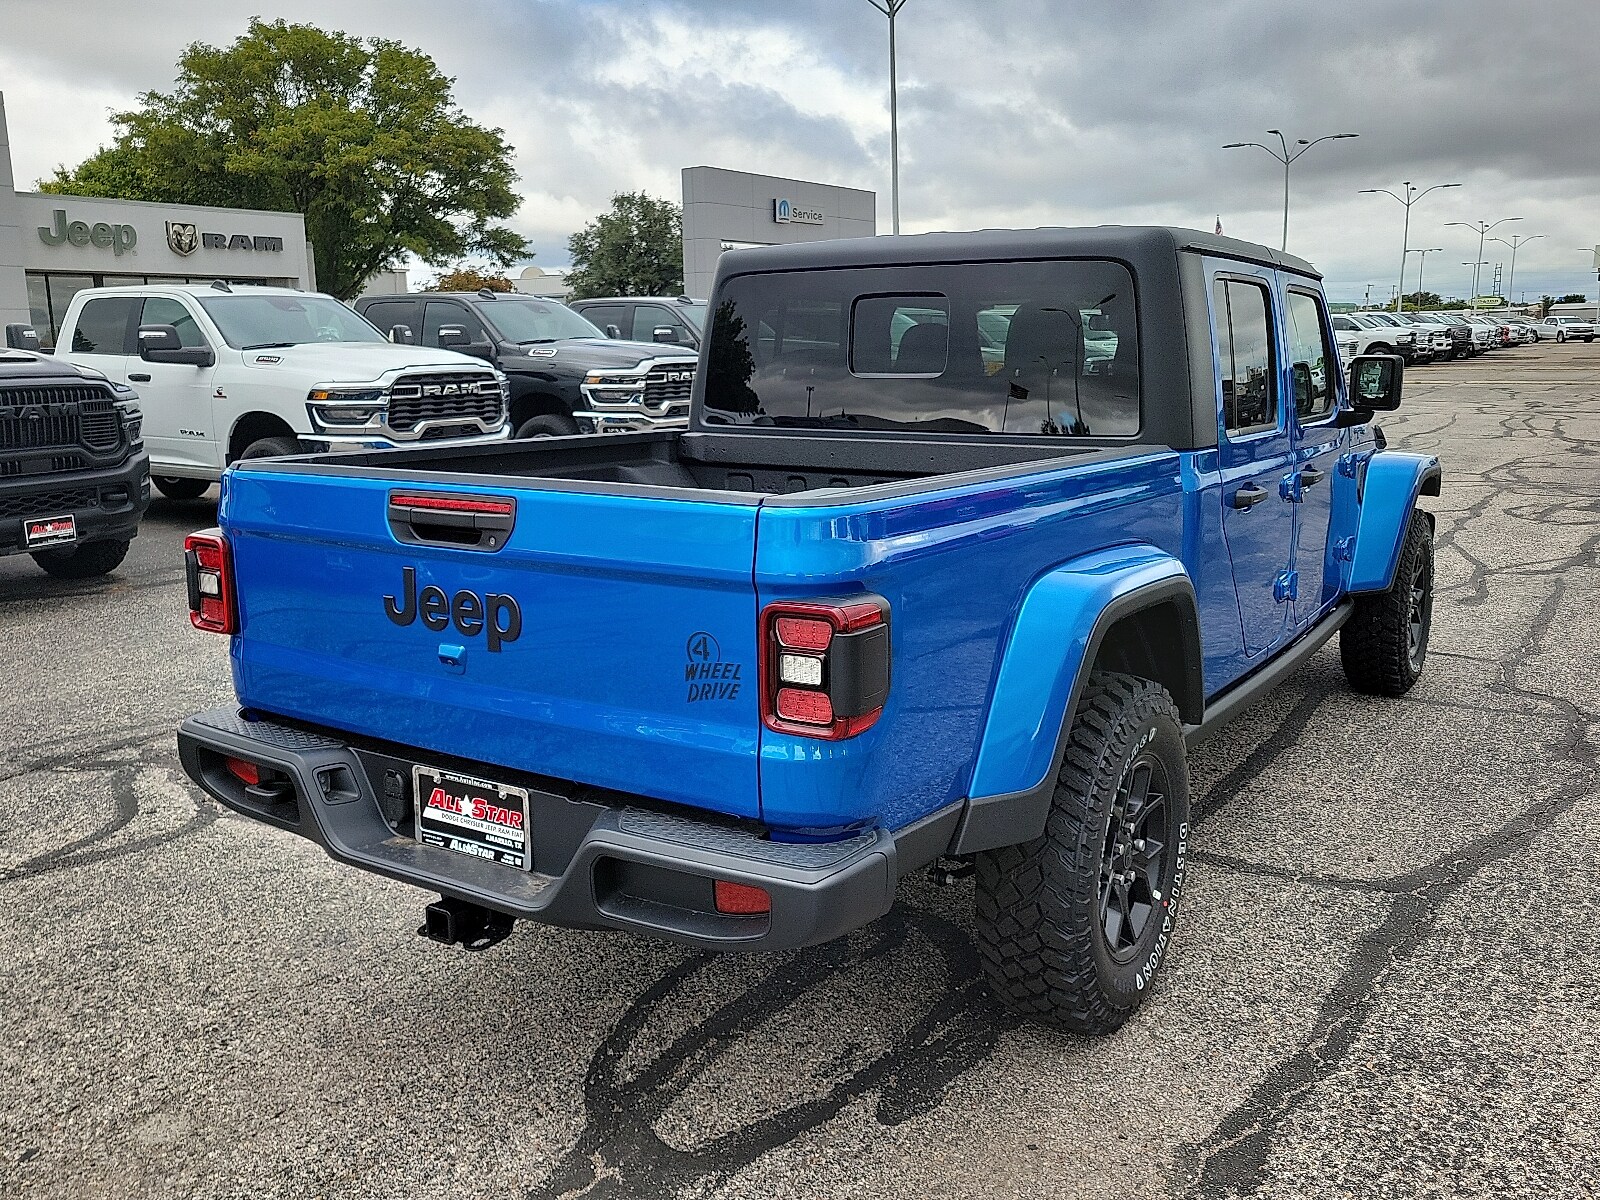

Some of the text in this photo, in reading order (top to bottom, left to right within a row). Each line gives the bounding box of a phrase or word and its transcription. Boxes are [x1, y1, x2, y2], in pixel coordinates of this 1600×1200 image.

[792, 207, 823, 221] Service
[38, 210, 137, 256] Jeep
[202, 233, 283, 252] RAM
[422, 383, 481, 397] RAM
[382, 566, 522, 653] Jeep
[692, 636, 709, 661] 4
[685, 662, 741, 681] WHEEL
[687, 683, 741, 703] DRIVE
[472, 797, 523, 829] STAR
[441, 812, 459, 823] DODGE
[460, 817, 484, 830] CHRYSLER
[511, 830, 523, 839] FIAT
[514, 841, 523, 850] TX
[1142, 822, 1188, 981] DESTINATION
